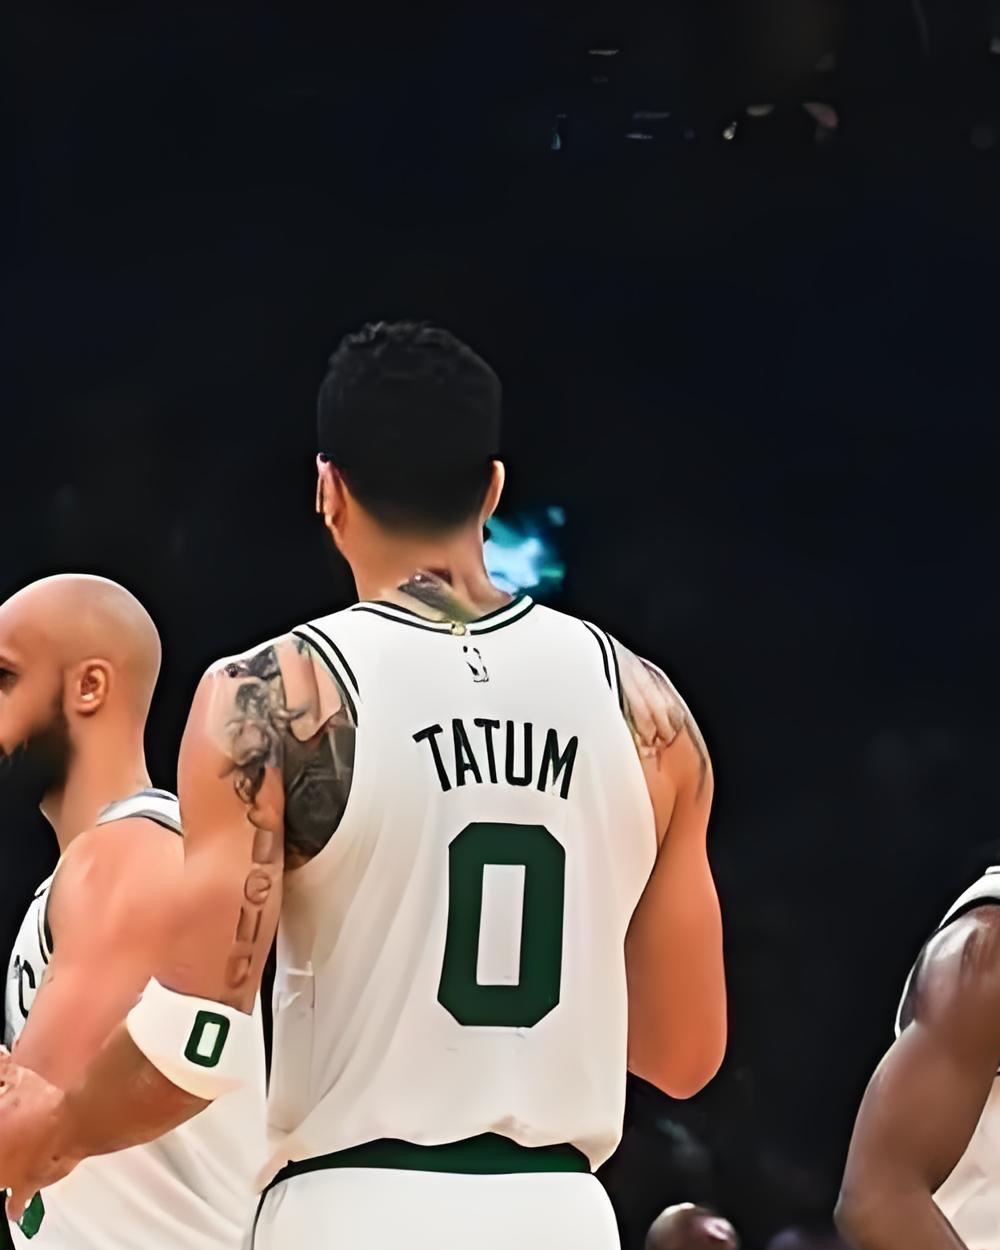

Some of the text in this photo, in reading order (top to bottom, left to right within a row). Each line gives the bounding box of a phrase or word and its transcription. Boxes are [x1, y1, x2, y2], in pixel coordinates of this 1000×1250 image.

[412, 717, 579, 800] TATUM
[437, 821, 566, 1029] 0
[184, 1009, 231, 1068] 0
